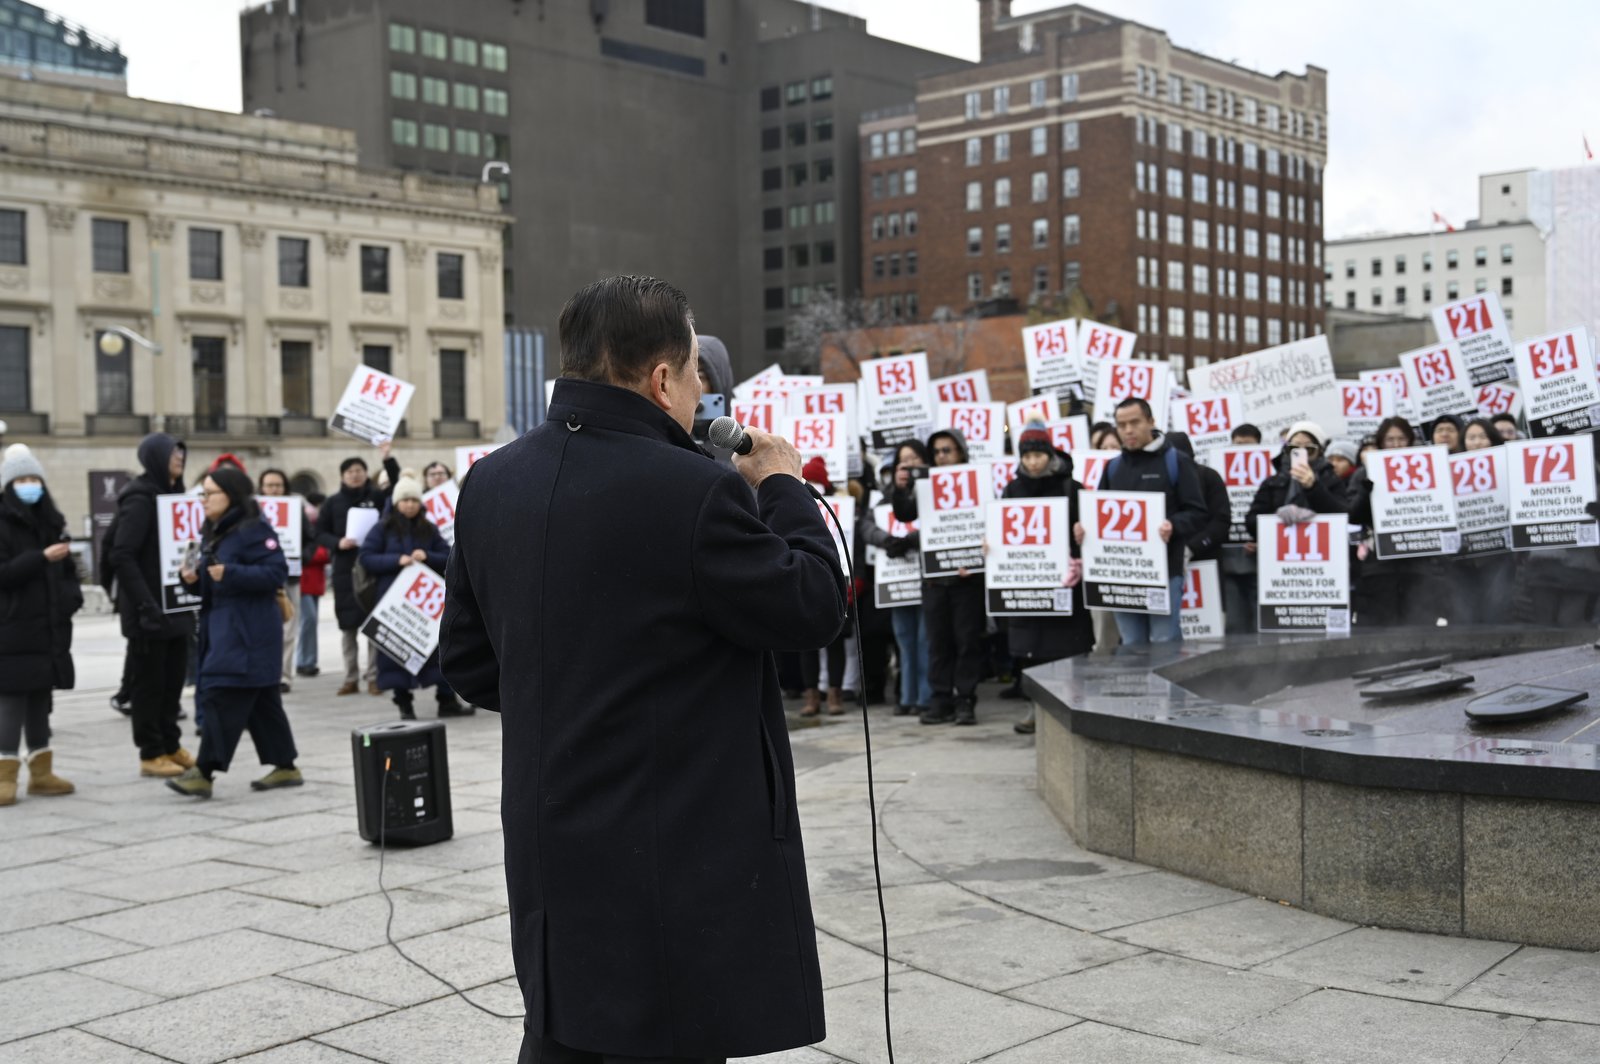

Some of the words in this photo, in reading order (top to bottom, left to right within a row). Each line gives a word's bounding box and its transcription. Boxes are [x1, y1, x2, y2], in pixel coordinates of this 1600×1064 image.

[1451, 300, 1484, 338] 27
[1037, 328, 1065, 357] 25
[1090, 329, 1117, 358] 31
[1462, 346, 1486, 356] AITING
[1534, 336, 1573, 377] 34
[1418, 350, 1451, 385] 63
[880, 361, 912, 394] 53
[1114, 365, 1149, 399] 39
[1540, 375, 1576, 390] MONTHS
[943, 380, 974, 402] 19
[1533, 388, 1568, 402] WAITING
[1571, 383, 1587, 392] FOR
[1347, 387, 1378, 416] 29
[1478, 385, 1511, 413] 25
[1550, 391, 1594, 409] RESPONSE
[1191, 399, 1227, 434] 34
[954, 409, 988, 440] 68
[798, 419, 831, 448] 53
[1229, 451, 1267, 486] 40
[1528, 445, 1570, 483] 72
[1389, 453, 1431, 492] 33
[1453, 456, 1492, 495] 28
[938, 471, 975, 509] 31
[1231, 489, 1256, 498] MONT
[1530, 486, 1571, 497] MONTHS
[1393, 495, 1432, 504] MONTHS
[1458, 496, 1494, 507] MONTHS
[1521, 498, 1562, 508] WAITING
[1564, 496, 1583, 505] FOR
[1385, 505, 1423, 516] WAITING
[1425, 504, 1443, 512] FOR
[1456, 508, 1486, 519] AITING
[1488, 505, 1505, 514] FOR
[1516, 511, 1537, 519] IRCC
[1540, 508, 1584, 518] RESPONS
[175, 502, 206, 540] 30
[939, 512, 976, 522] MONTHS
[1101, 500, 1143, 541] 22
[1402, 515, 1450, 526] RESPONSE
[932, 522, 966, 534] WAITING
[1006, 506, 1047, 544] 34
[1526, 525, 1538, 535] NO
[1539, 522, 1580, 533] TIMELINE
[946, 534, 984, 544] RESPON
[1284, 523, 1323, 560] 11
[1391, 533, 1402, 543] NO
[1530, 534, 1542, 543] NO
[1103, 545, 1143, 555] MONTHS
[1395, 541, 1407, 551] NO
[1007, 551, 1046, 559] MONTHS
[998, 563, 1036, 571] WAITING
[1038, 562, 1057, 570] FOR
[1094, 557, 1133, 567] WAITING
[1135, 558, 1153, 568] FOR
[1089, 568, 1107, 577] IRCC
[1110, 569, 1159, 580] RESPONSE
[1282, 567, 1324, 576] MONTHS
[1014, 573, 1062, 583] RESPONSE
[1271, 579, 1313, 588] WAITING
[1316, 579, 1335, 588] FOR
[1098, 584, 1110, 594] NO
[1265, 590, 1286, 599] IRCC
[1288, 590, 1341, 599] RESPONSE
[409, 577, 445, 616] 38
[1102, 594, 1114, 604] NO
[1275, 606, 1287, 616] NO
[1288, 605, 1331, 616] TIMELINE
[1278, 616, 1291, 626] NO
[1192, 625, 1211, 634] FOR
